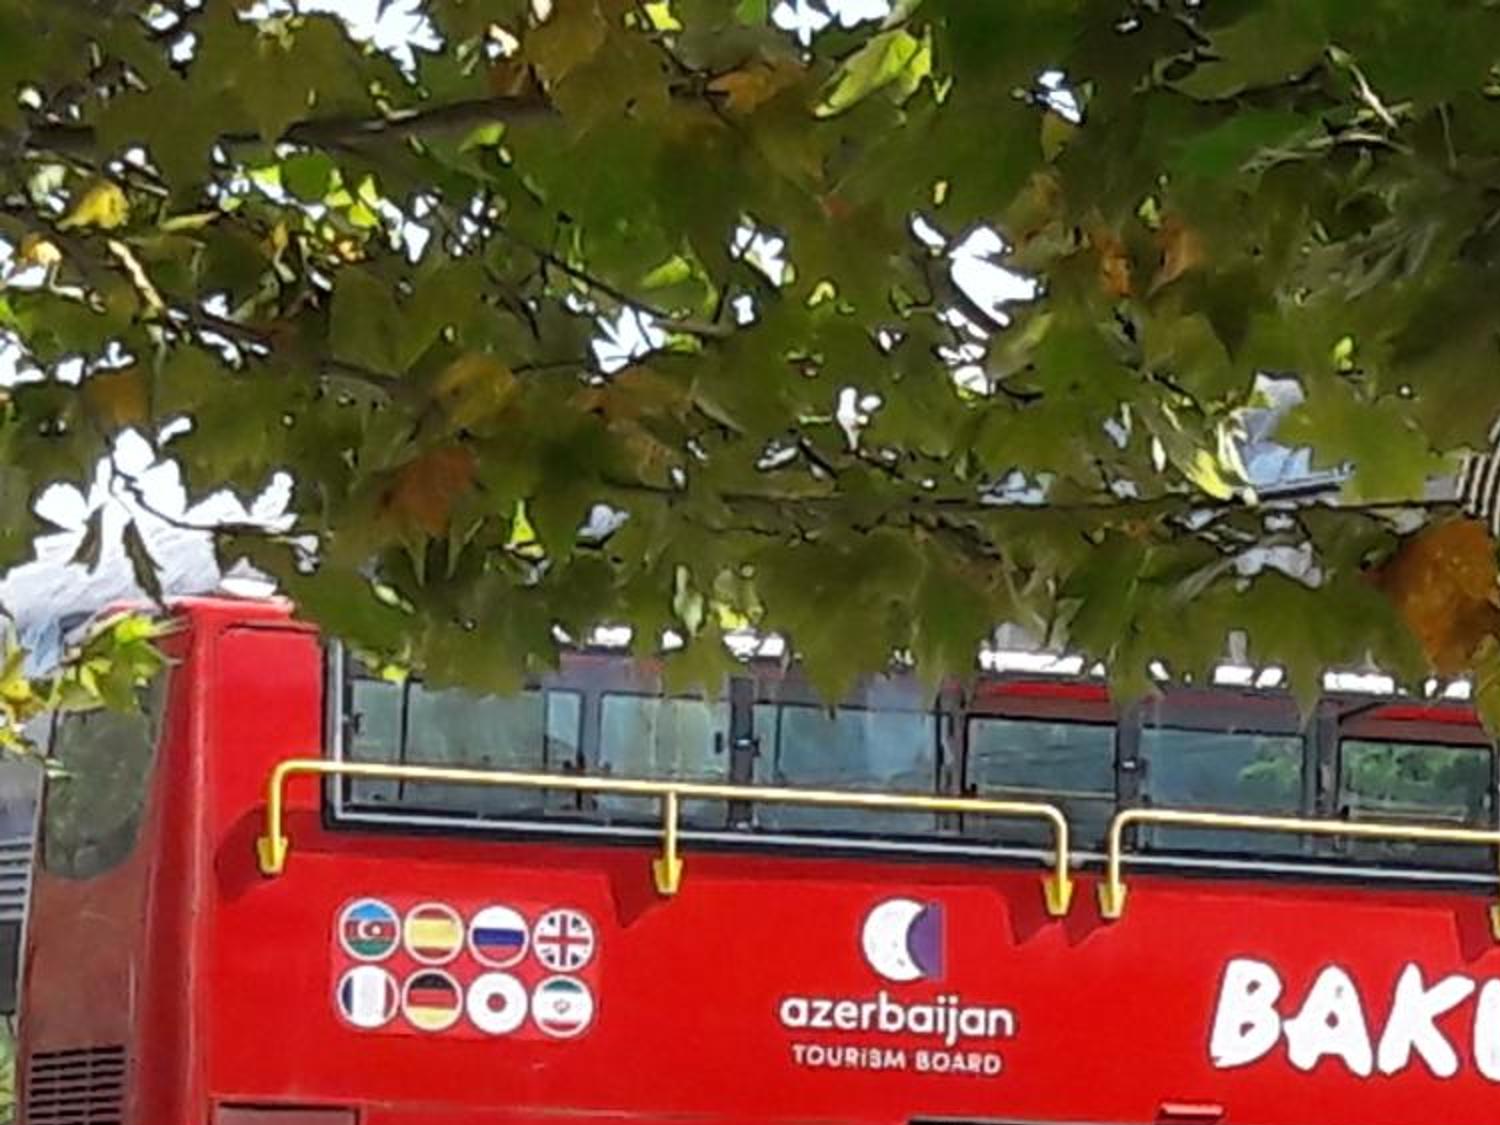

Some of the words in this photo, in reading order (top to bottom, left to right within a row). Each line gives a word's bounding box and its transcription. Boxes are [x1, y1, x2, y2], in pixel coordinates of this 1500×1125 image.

[780, 991, 1014, 1046] azerbaijan
[793, 1045, 905, 1069] TOURISM
[915, 1050, 1001, 1075] BOARD
